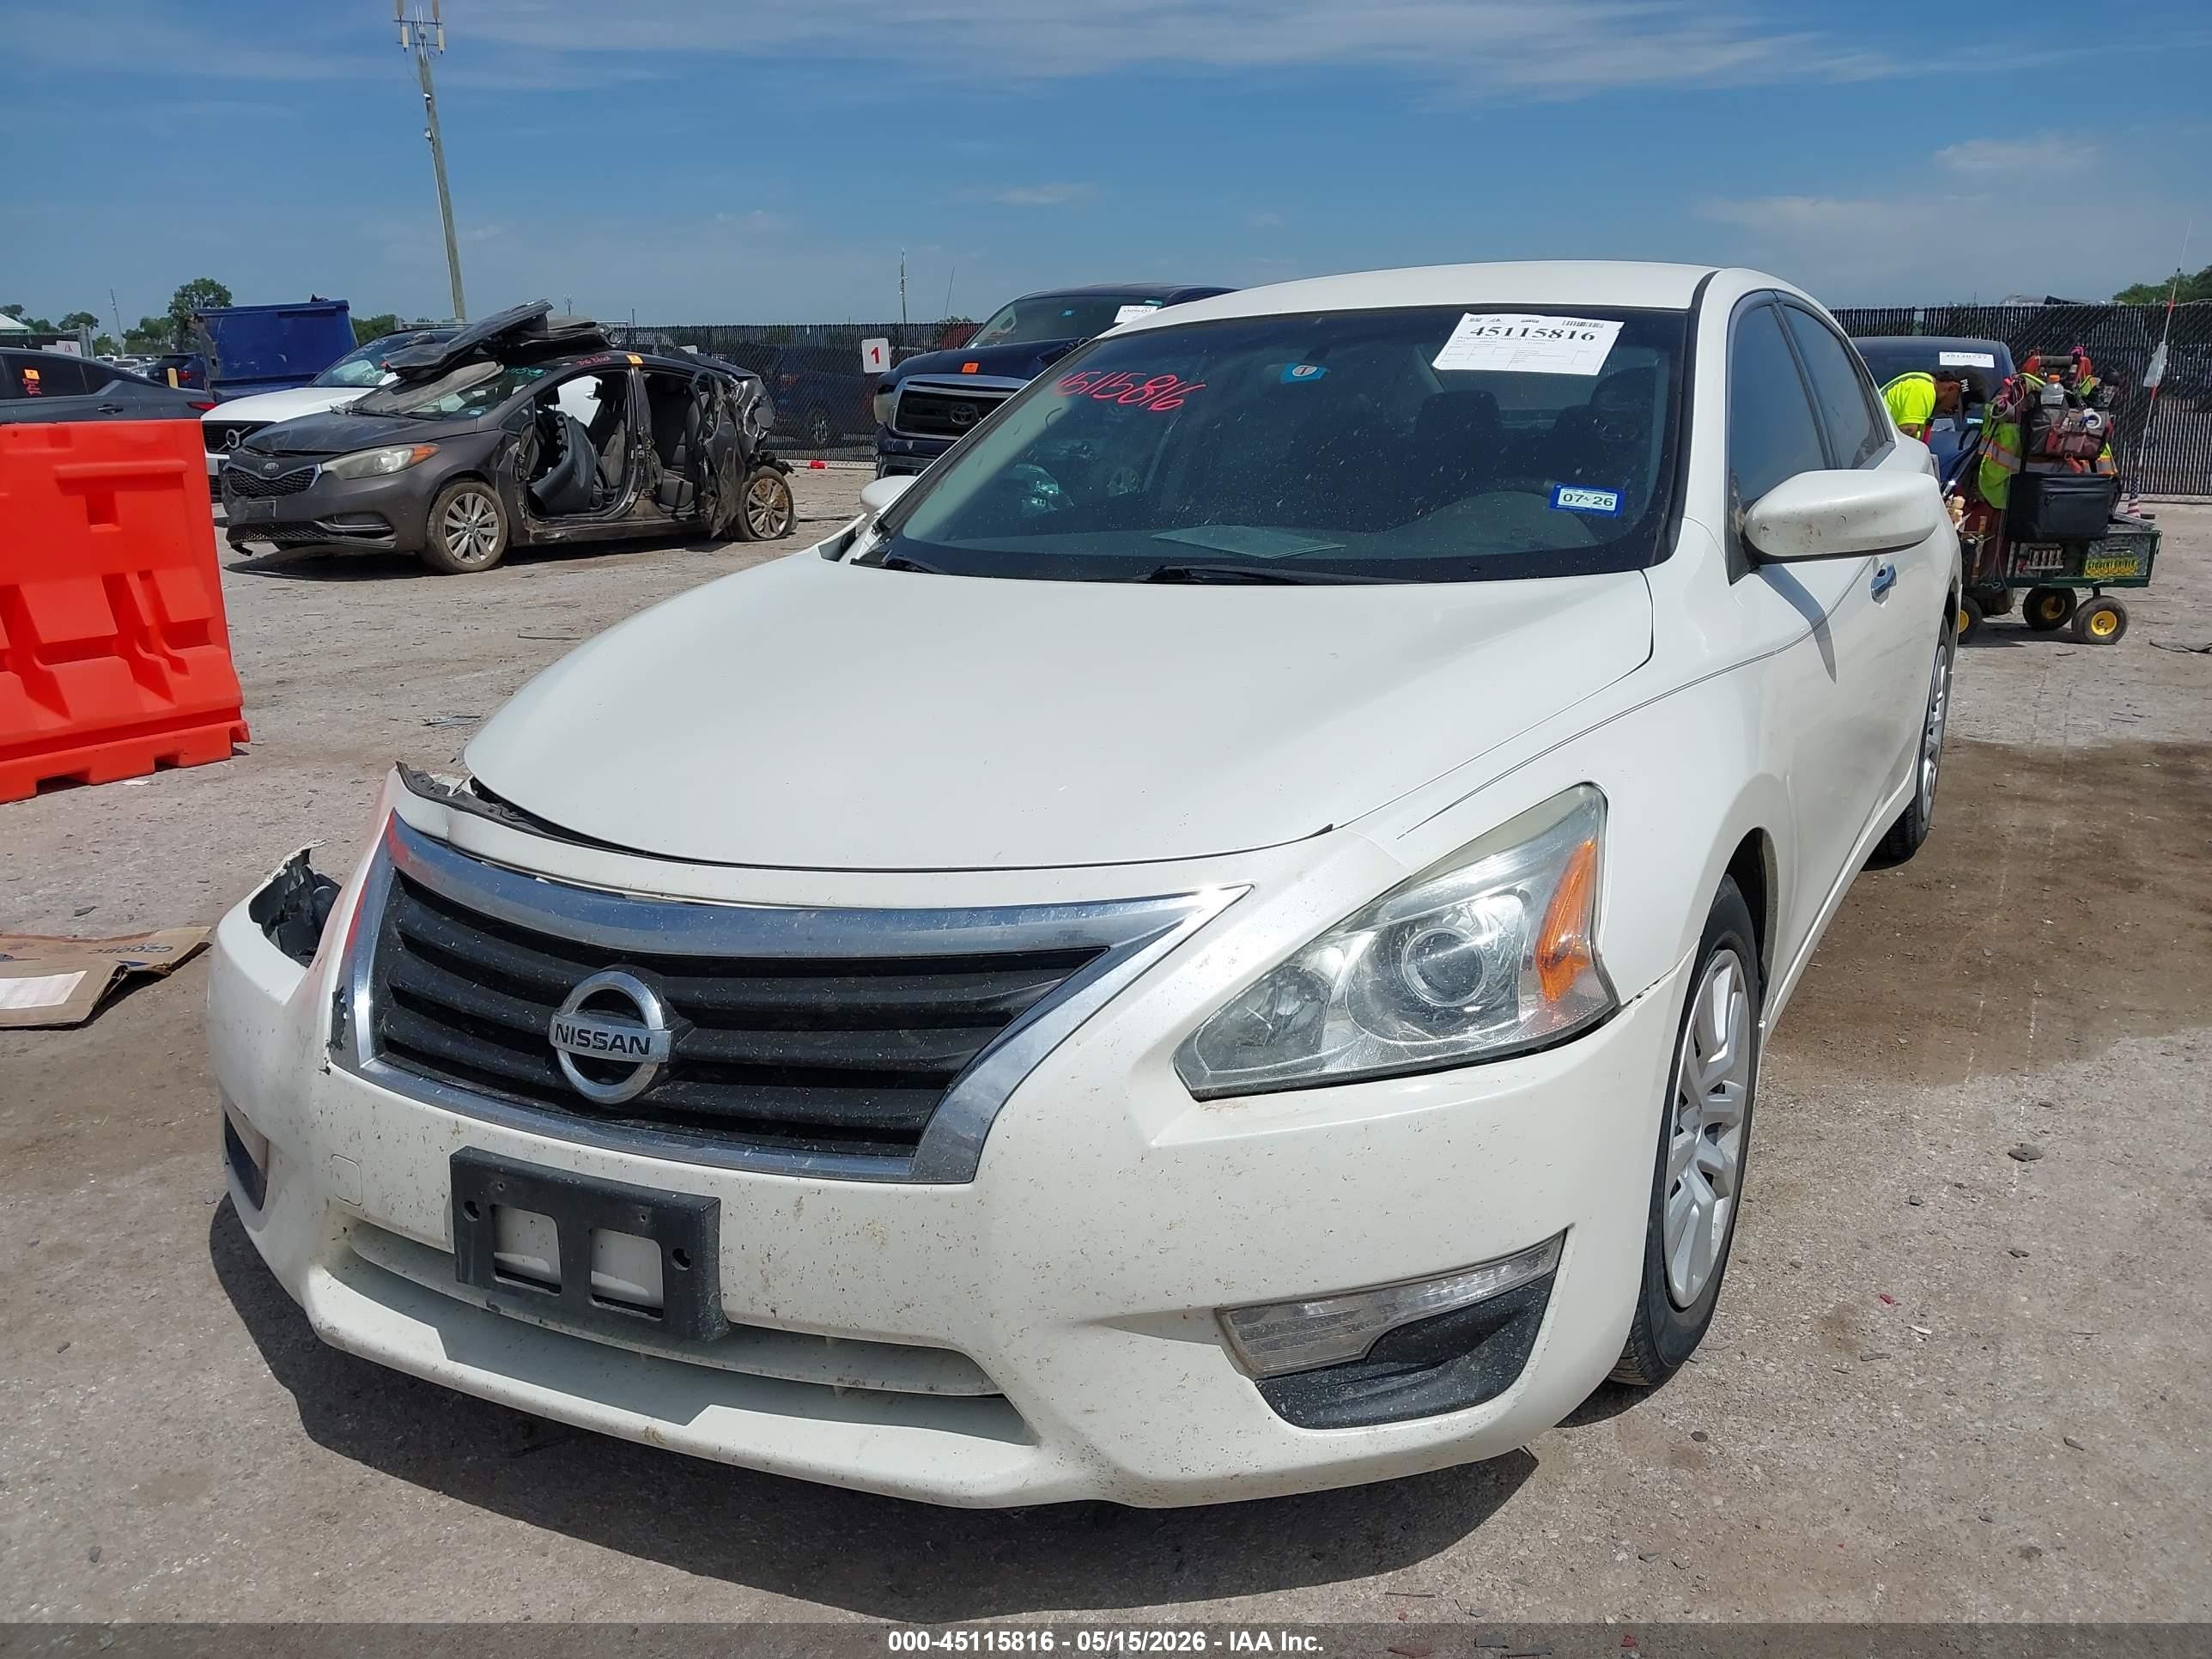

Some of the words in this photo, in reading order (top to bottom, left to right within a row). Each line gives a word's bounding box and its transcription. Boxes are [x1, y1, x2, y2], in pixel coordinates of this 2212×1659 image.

[1469, 326, 1600, 341] 45115816
[871, 346, 880, 364] 1
[1563, 493, 1584, 503] 07
[1592, 496, 1614, 507] 26
[555, 1023, 651, 1055] NISSAN
